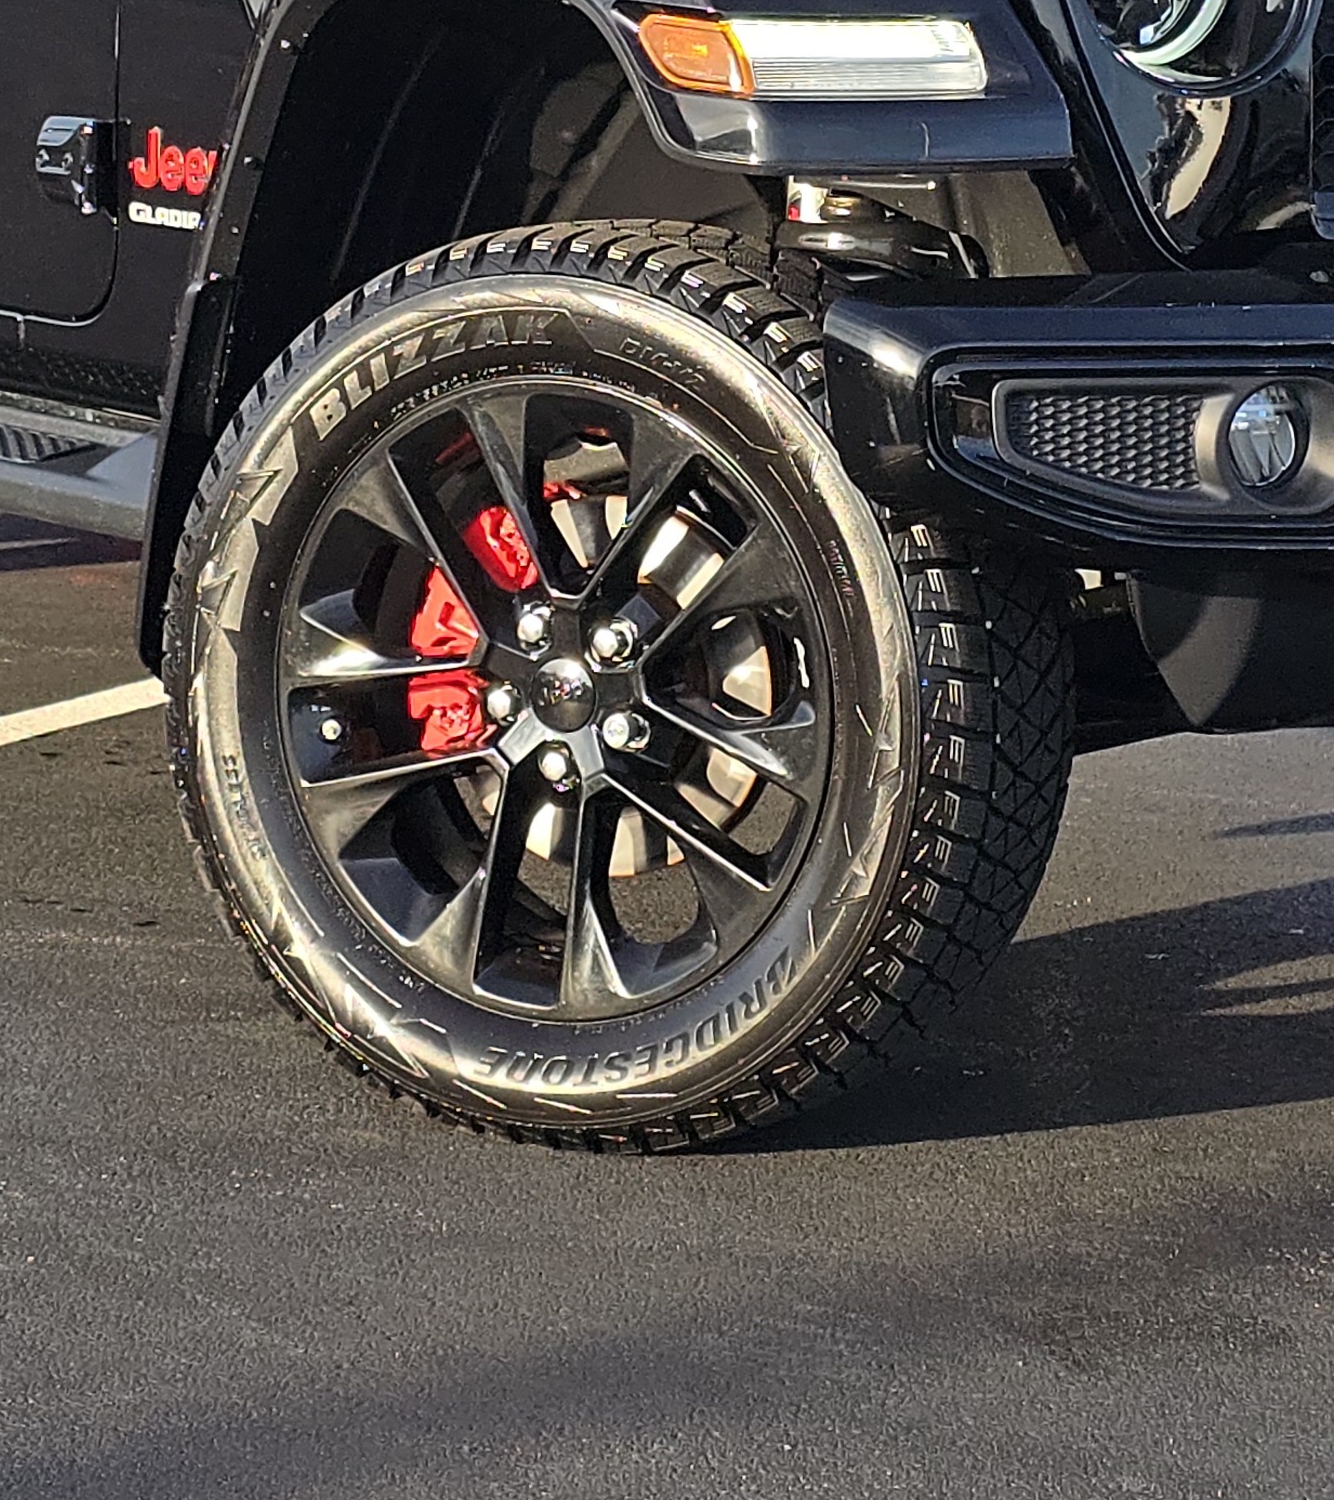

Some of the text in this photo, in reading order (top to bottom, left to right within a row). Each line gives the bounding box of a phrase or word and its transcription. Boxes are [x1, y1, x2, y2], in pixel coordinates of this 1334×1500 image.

[128, 201, 204, 231] GLADIA
[308, 310, 561, 441] BLIZZAK
[473, 944, 796, 1086] BRIDGESTONE
